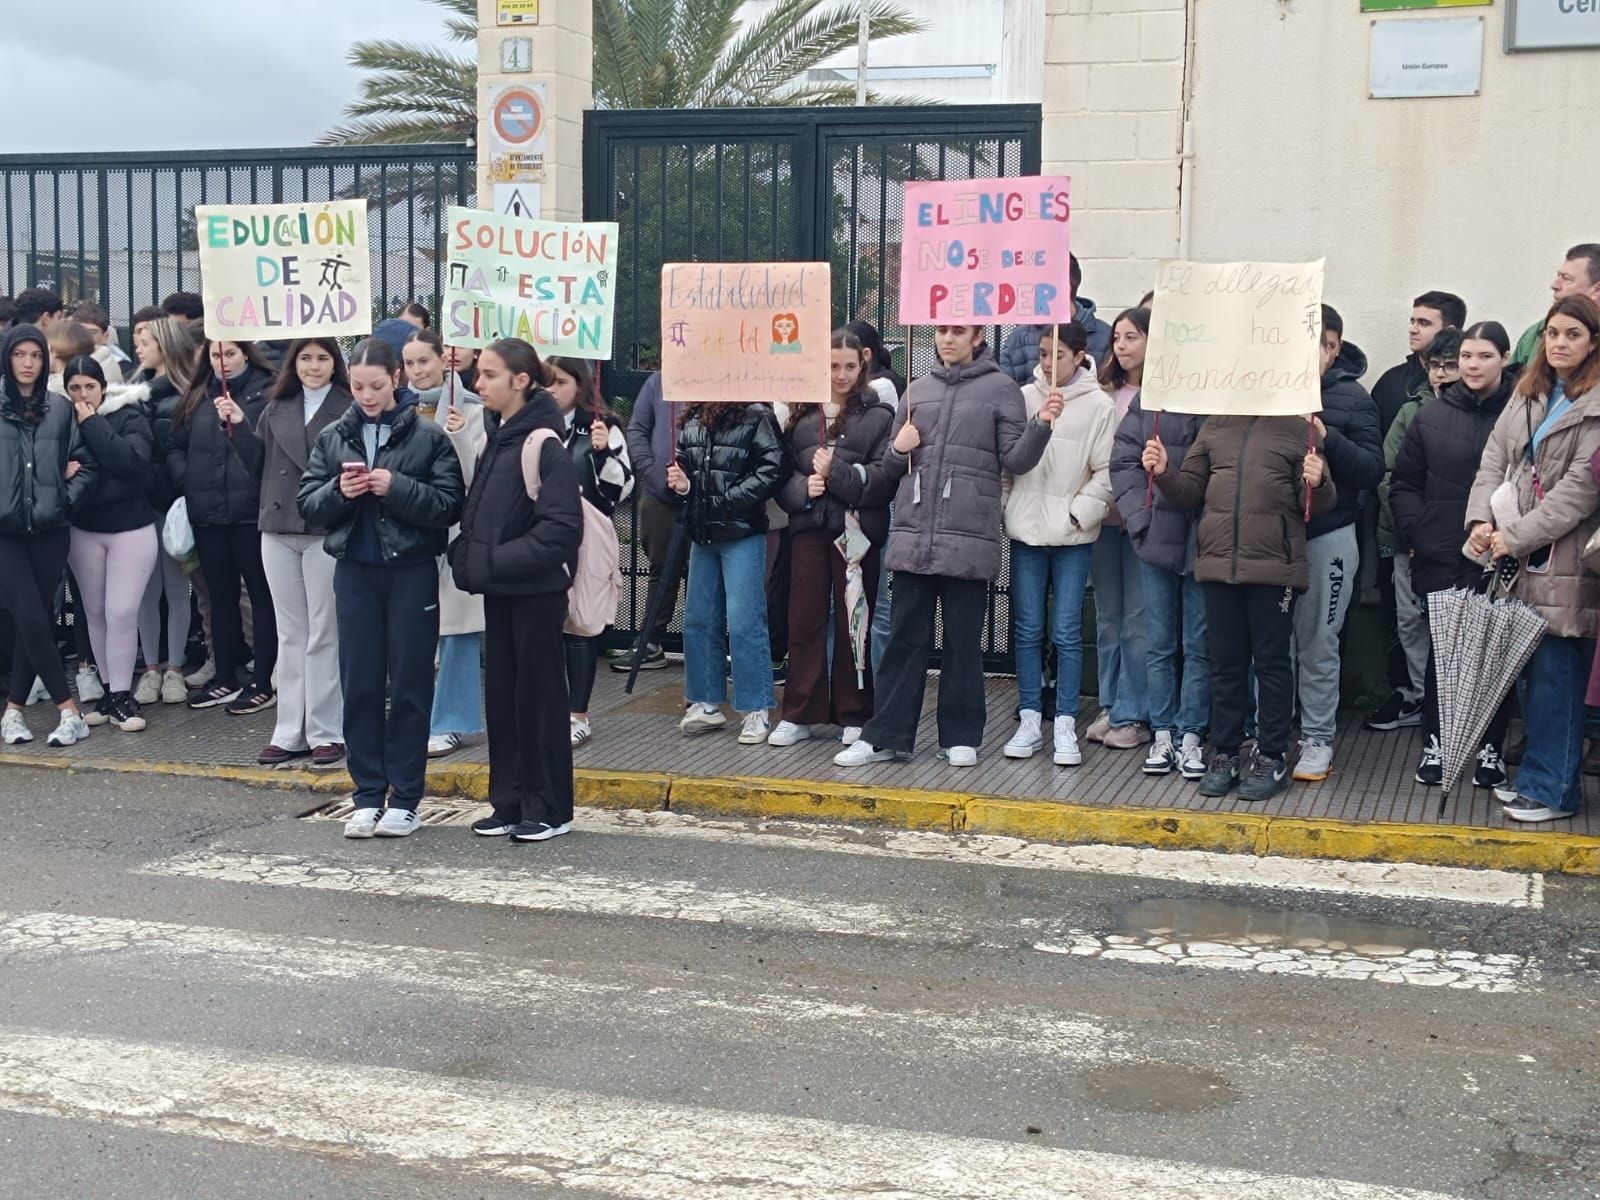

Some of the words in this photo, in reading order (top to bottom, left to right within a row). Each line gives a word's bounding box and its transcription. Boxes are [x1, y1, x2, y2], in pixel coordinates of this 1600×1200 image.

[508, 46, 520, 68] 4
[918, 203, 949, 227] EL
[954, 185, 1070, 226] INGLÉS
[256, 255, 299, 288] DE
[1001, 249, 1046, 269] DEBE
[519, 274, 605, 305] ESTA
[930, 282, 1057, 320] PERDER
[216, 289, 358, 328] CALIDAD
[1250, 315, 1290, 345] ha
[1326, 572, 1344, 626] Joma
